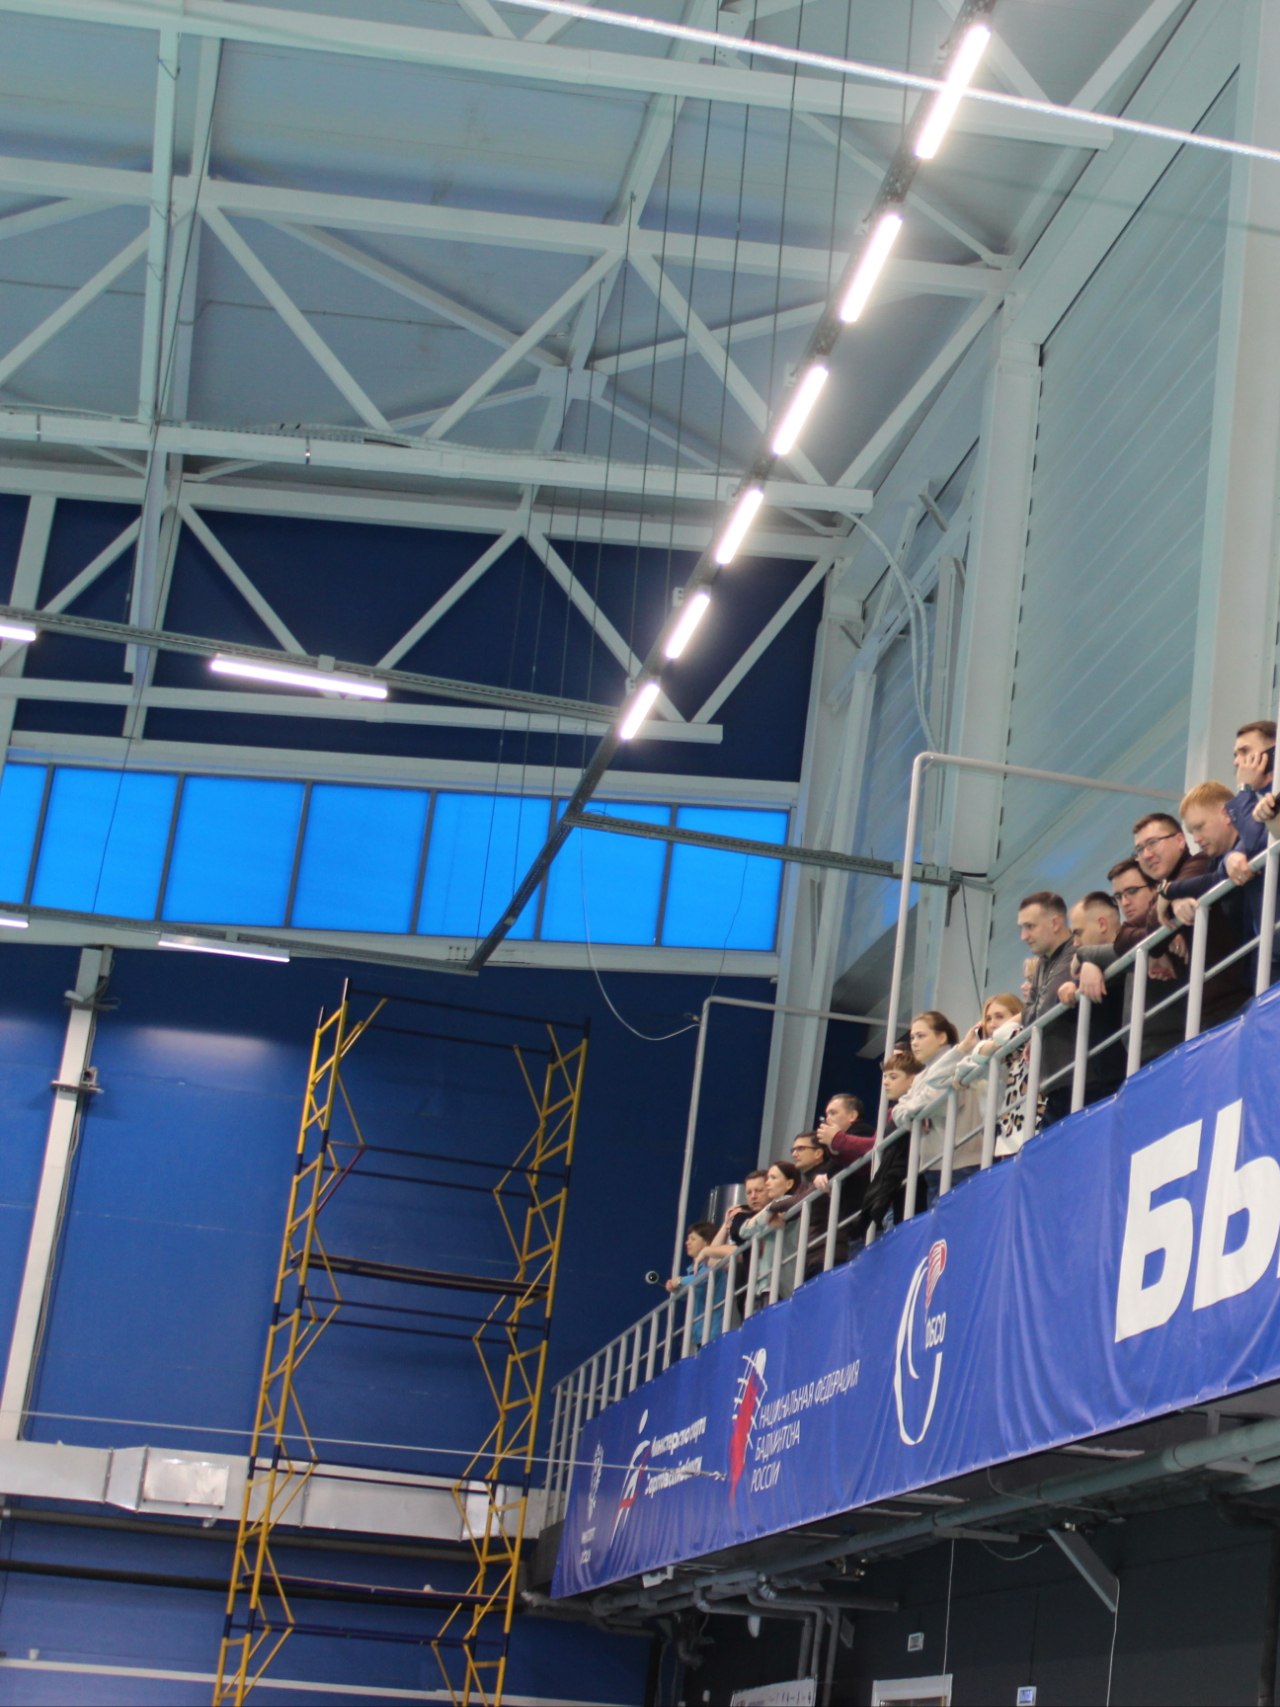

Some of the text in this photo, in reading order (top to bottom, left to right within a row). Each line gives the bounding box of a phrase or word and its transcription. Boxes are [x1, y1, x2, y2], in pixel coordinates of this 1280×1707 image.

[815, 1359, 860, 1405] ФЕДЕРАЦИЯ
[755, 1419, 800, 1463] БАДМИНТОНА
[750, 1460, 781, 1493] РОССИИ
